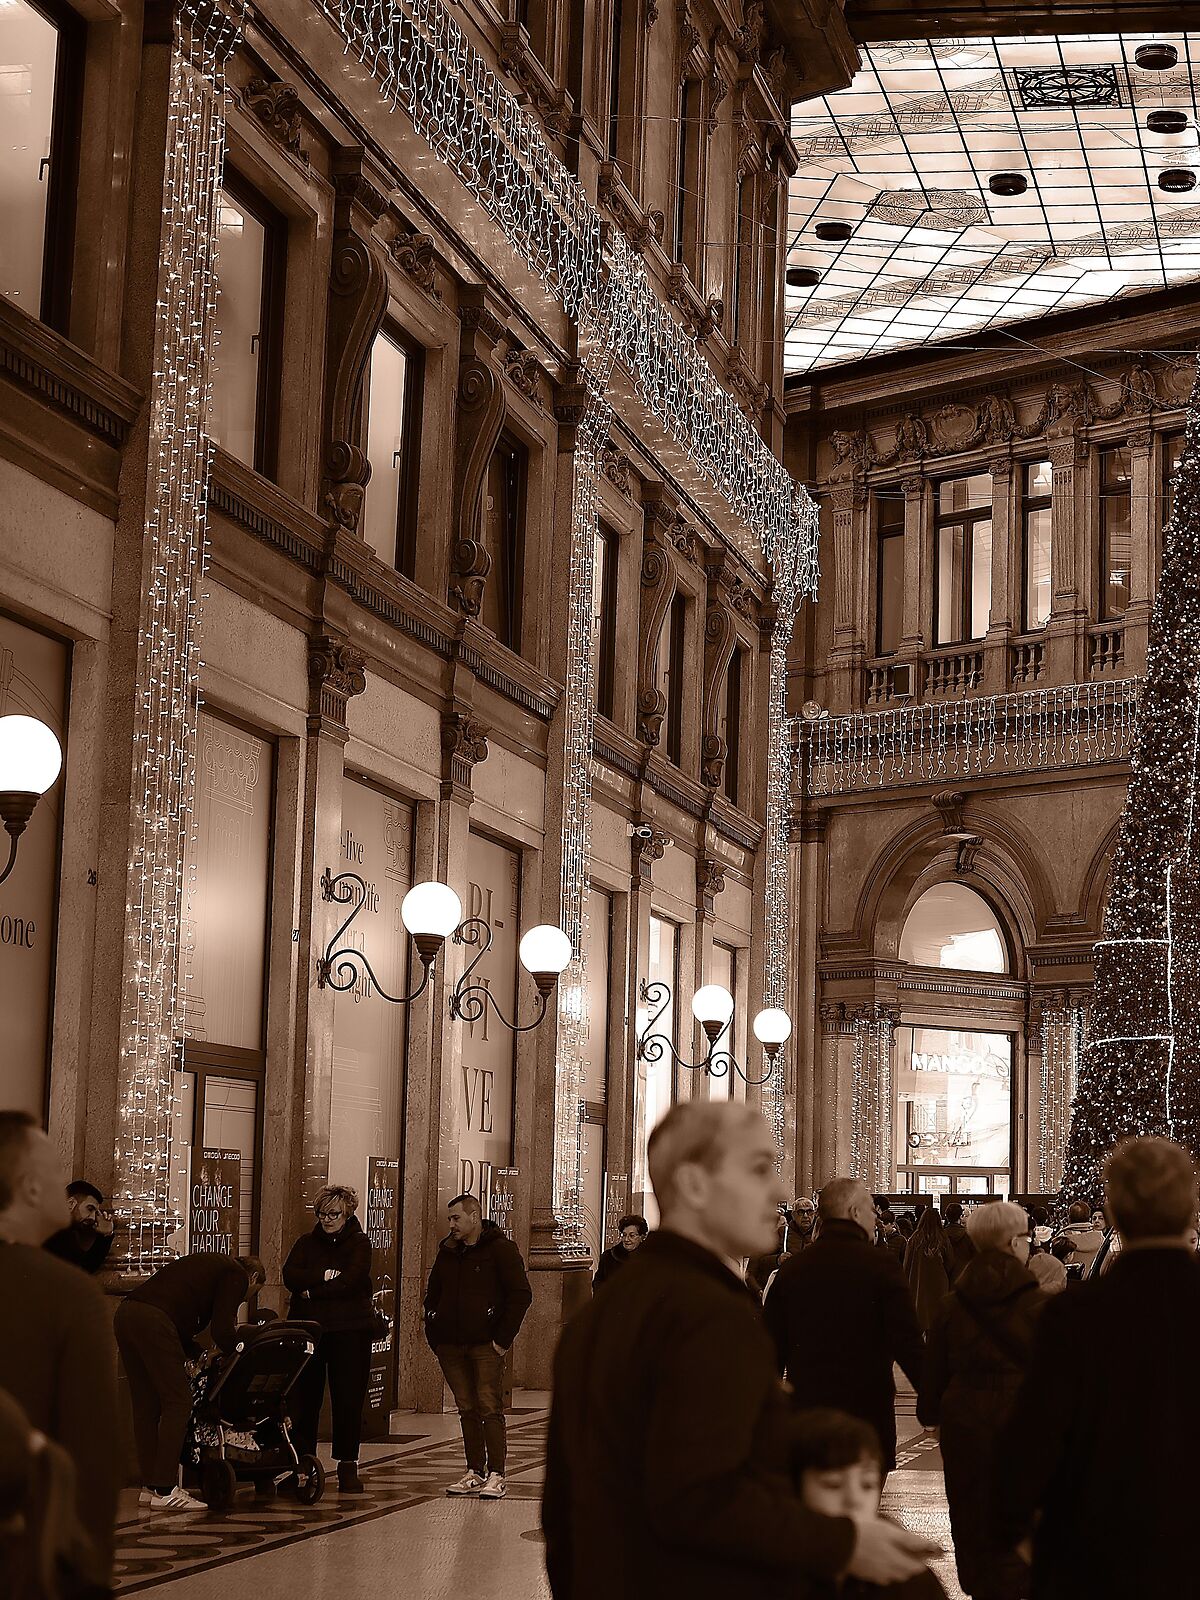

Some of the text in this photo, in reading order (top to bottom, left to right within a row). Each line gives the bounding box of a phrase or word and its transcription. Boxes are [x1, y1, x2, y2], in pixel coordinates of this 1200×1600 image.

[461, 1066, 494, 1133] VE
[192, 1184, 233, 1208] CHANGE
[368, 1188, 394, 1208] CHANGE
[490, 1194, 514, 1211] CHANGE
[192, 1209, 219, 1232] YOUR
[368, 1209, 386, 1229] YOUR
[191, 1233, 233, 1256] HABITAT
